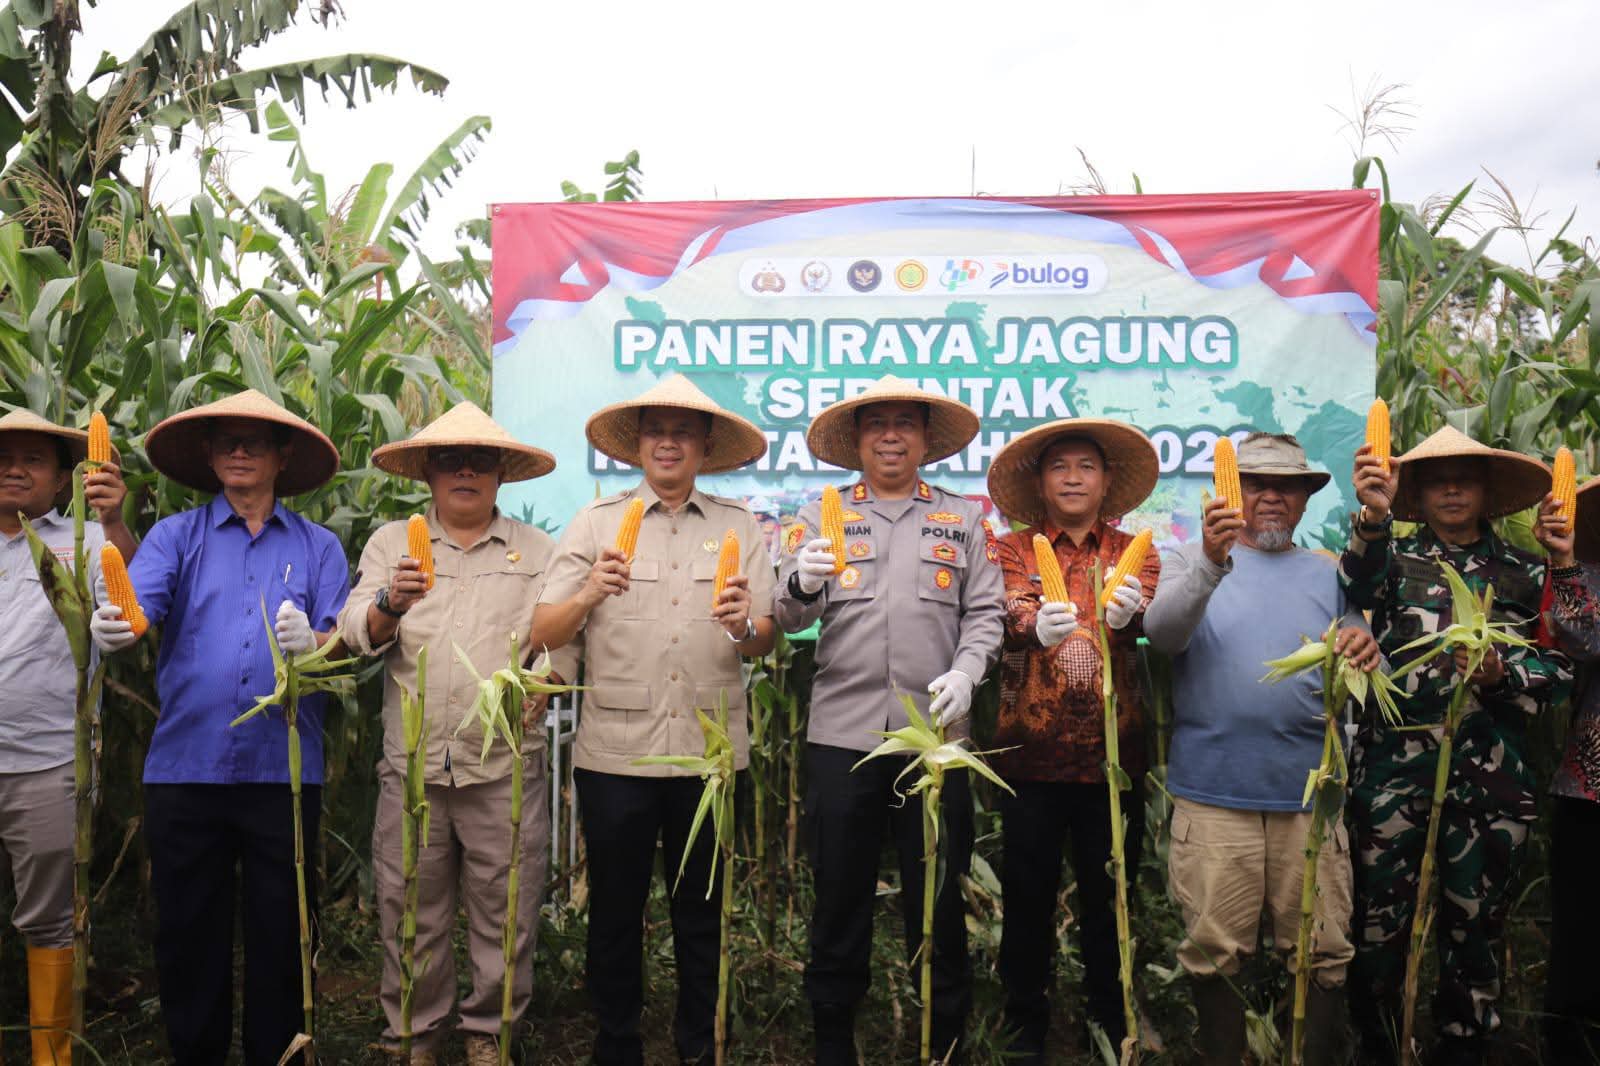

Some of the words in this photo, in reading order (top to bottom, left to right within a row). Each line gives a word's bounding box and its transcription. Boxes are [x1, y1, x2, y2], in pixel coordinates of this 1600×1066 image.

[1012, 262, 1089, 289] bulog
[620, 325, 809, 365] PANEN
[828, 324, 979, 365] RAYA
[993, 322, 1231, 365] JAGUNG
[767, 376, 1073, 419] SENTAK
[921, 527, 966, 543] POLRI
